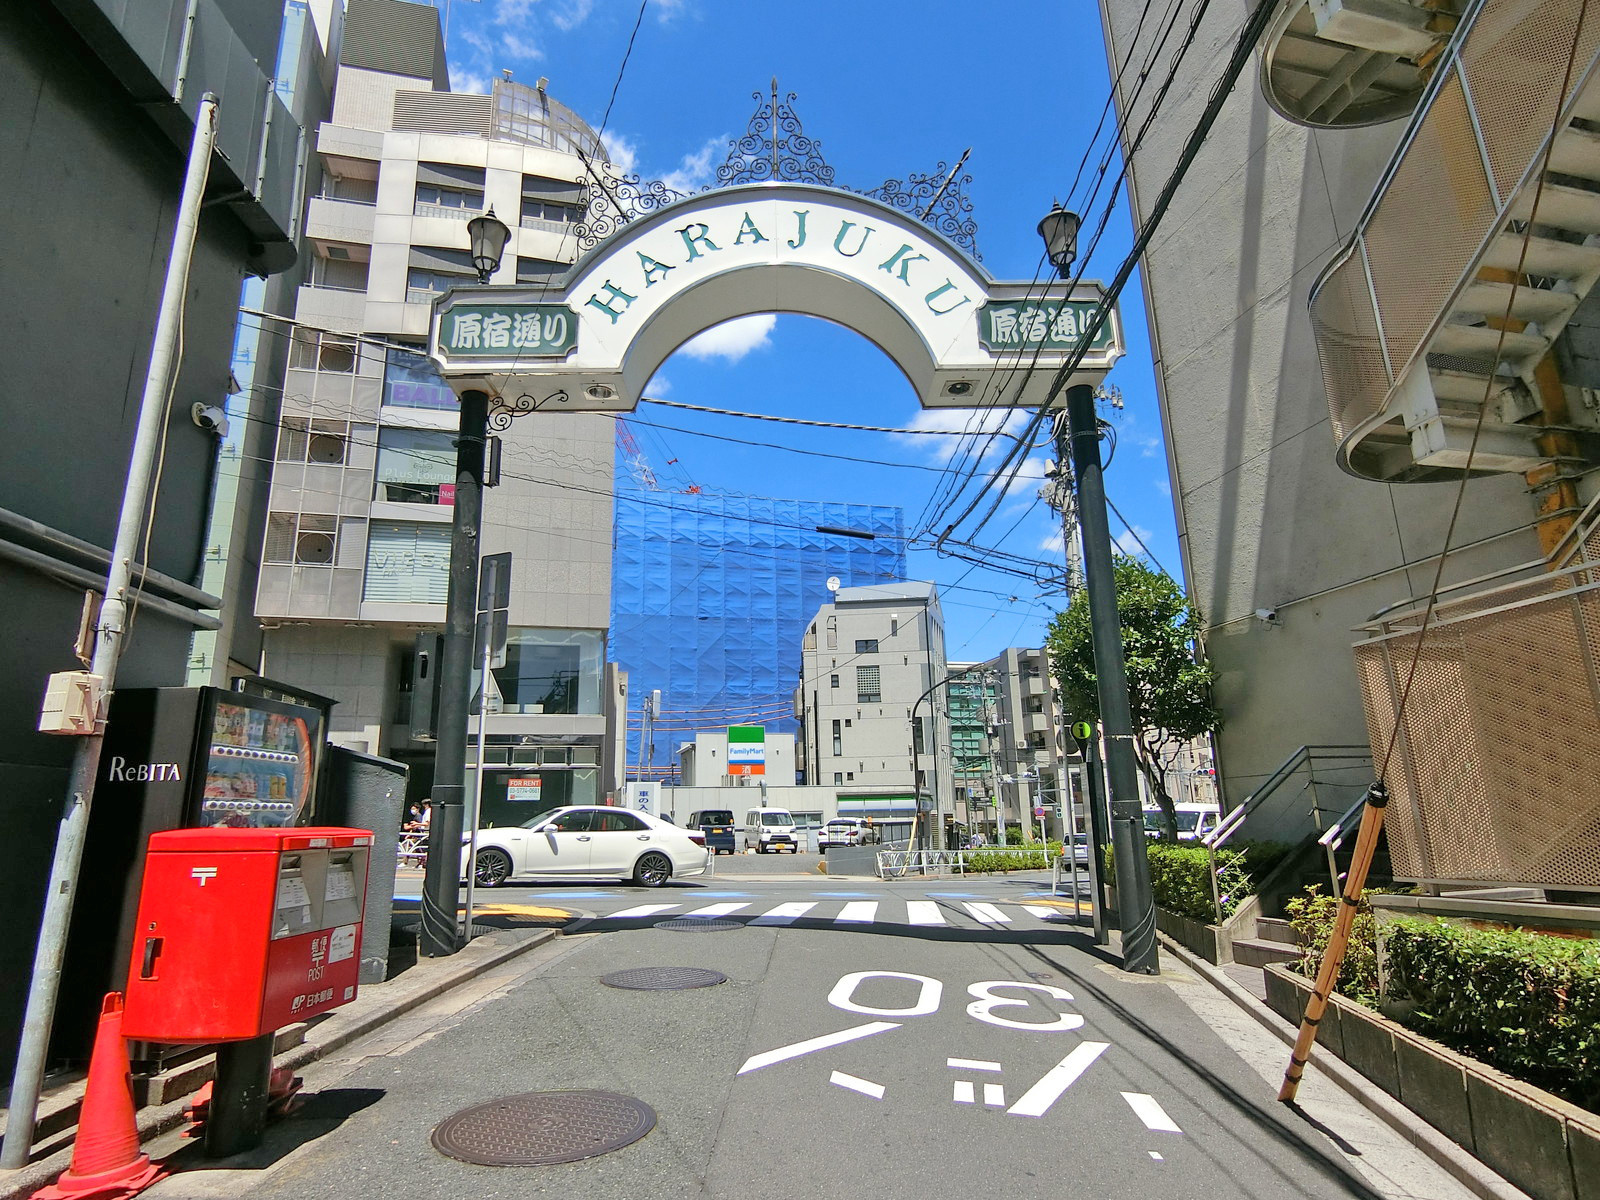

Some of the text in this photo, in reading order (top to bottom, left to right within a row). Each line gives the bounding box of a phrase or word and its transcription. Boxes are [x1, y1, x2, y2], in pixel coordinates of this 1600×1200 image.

[584, 210, 971, 325] HARAJUKU
[450, 312, 568, 349] 原宿通り
[385, 468, 413, 478] Plus
[742, 765, 752, 774] 酒
[638, 790, 649, 813] 車の入
[311, 936, 328, 954] 郵便
[308, 966, 325, 982] POST
[306, 988, 334, 1008] 日本郵便
[828, 970, 1086, 1032] 30
